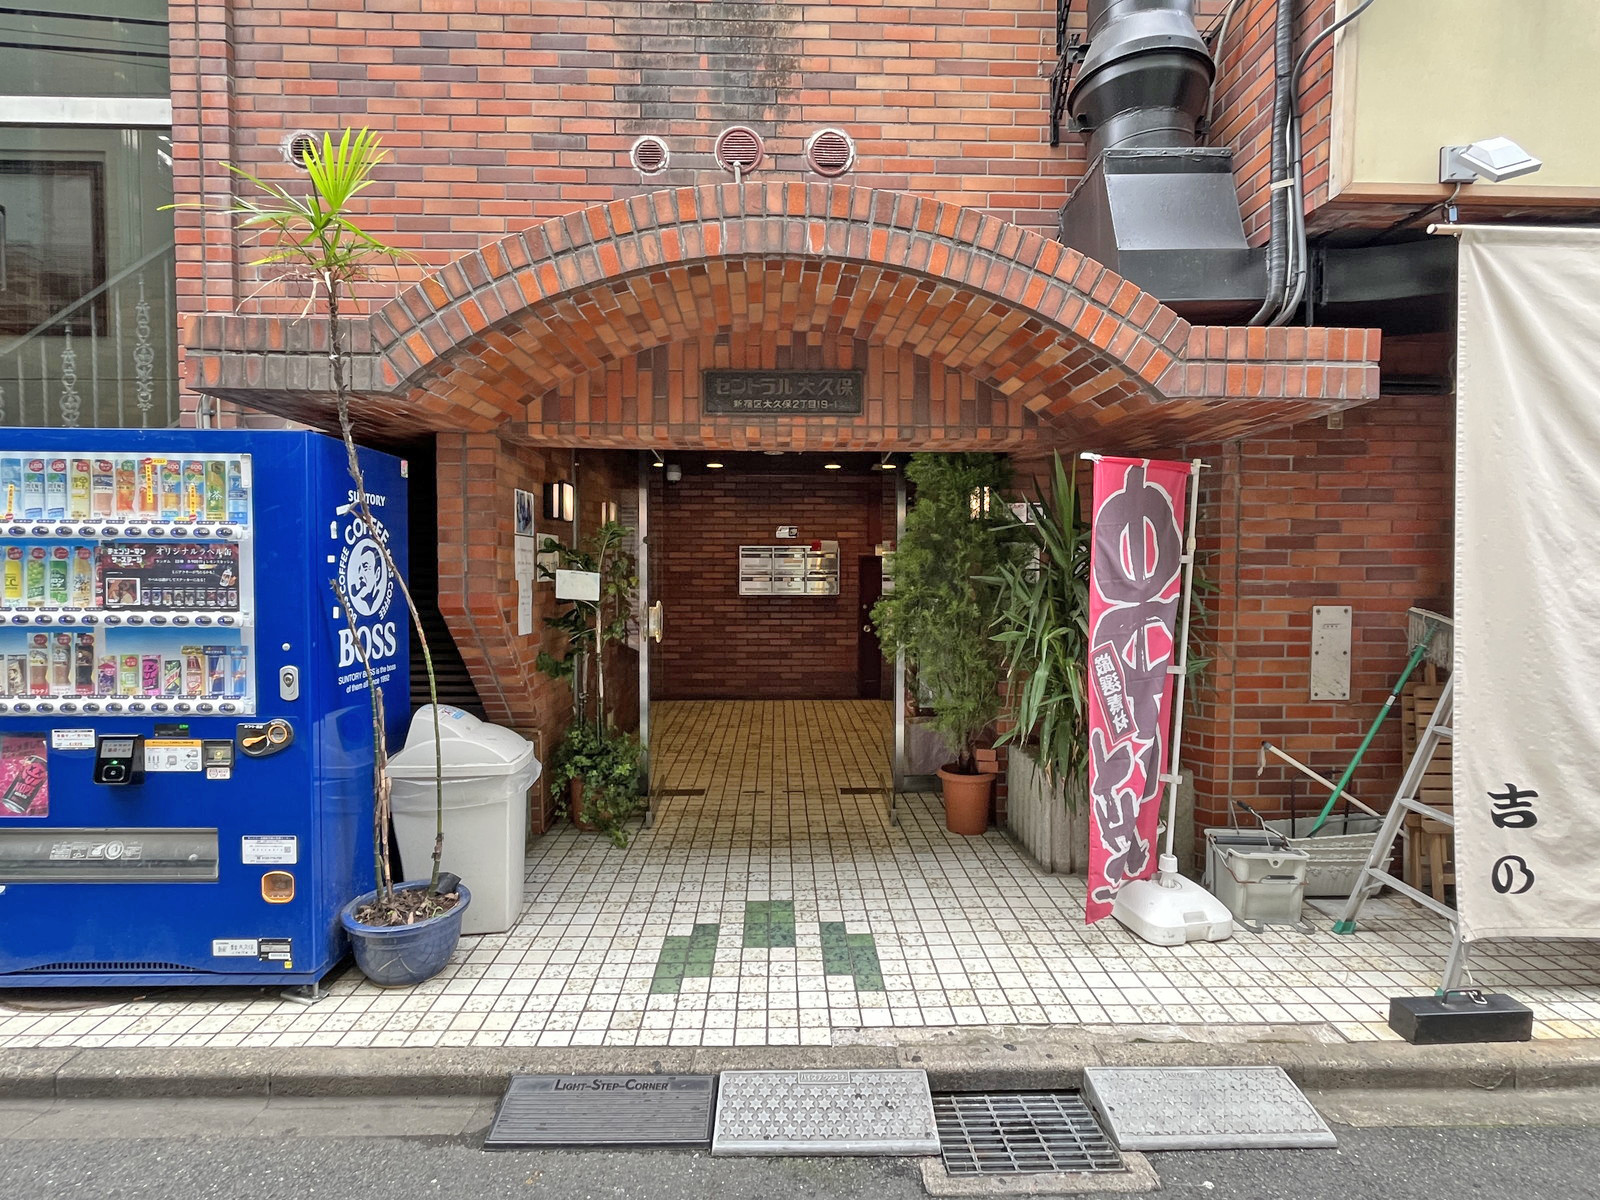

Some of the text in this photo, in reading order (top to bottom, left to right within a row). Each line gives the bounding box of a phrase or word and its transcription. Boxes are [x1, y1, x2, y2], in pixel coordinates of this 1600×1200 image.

[348, 490, 386, 506] SUTORY
[338, 622, 396, 667] BOSS
[338, 672, 362, 685] SUNTORY
[1487, 783, 1539, 894] 吉の
[554, 1078, 669, 1091] LIGHT-STEP-CORNER
